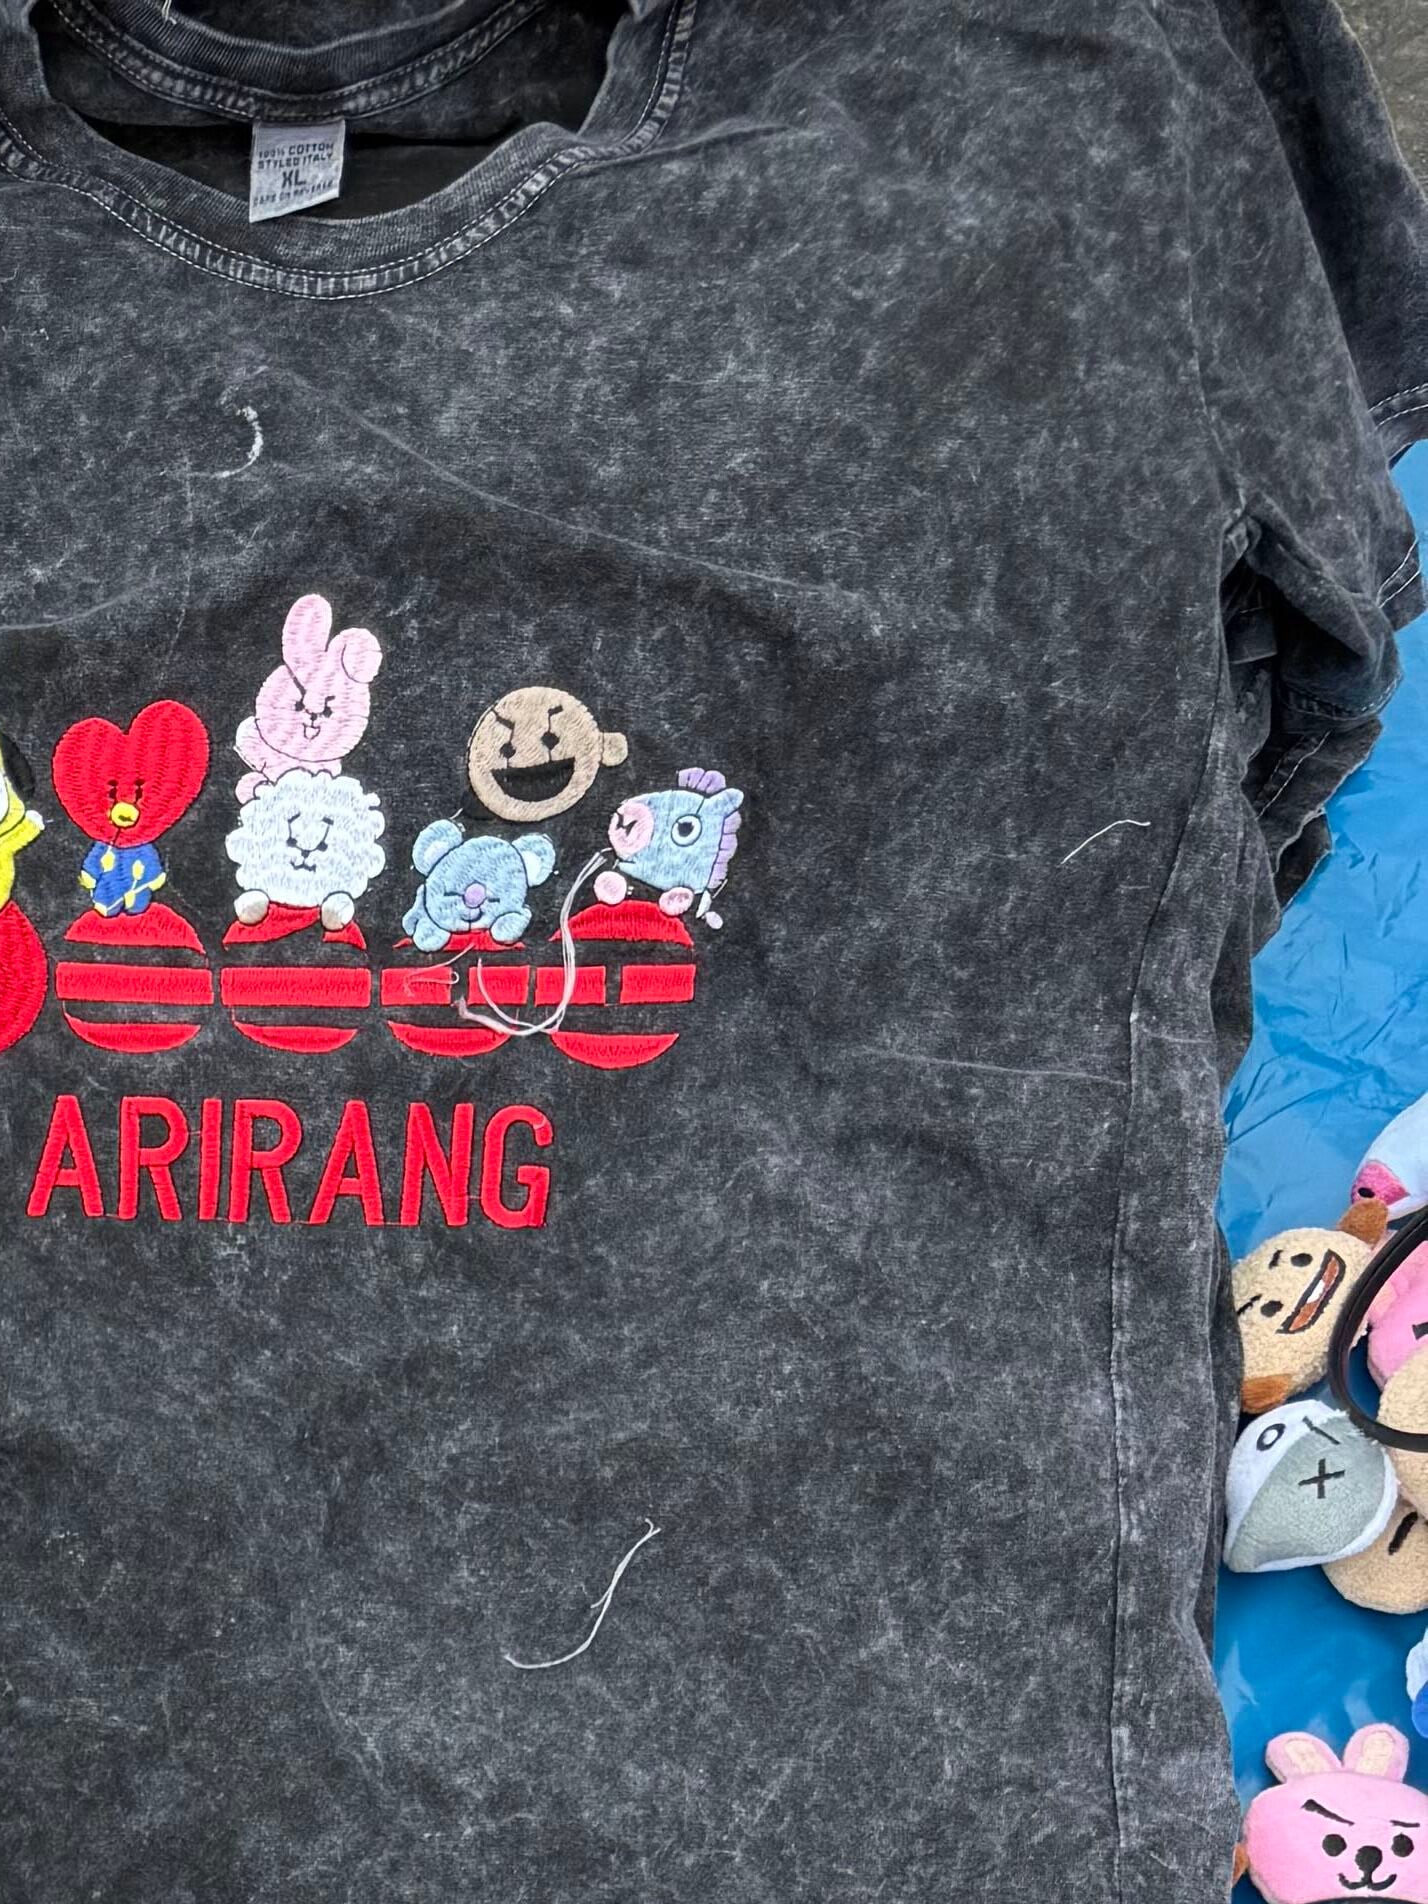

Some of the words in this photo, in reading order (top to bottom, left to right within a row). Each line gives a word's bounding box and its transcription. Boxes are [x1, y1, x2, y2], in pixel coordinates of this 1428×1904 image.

[287, 141, 334, 155] COTTON
[280, 168, 307, 188] XL
[25, 1093, 554, 1230] ARIRANG
